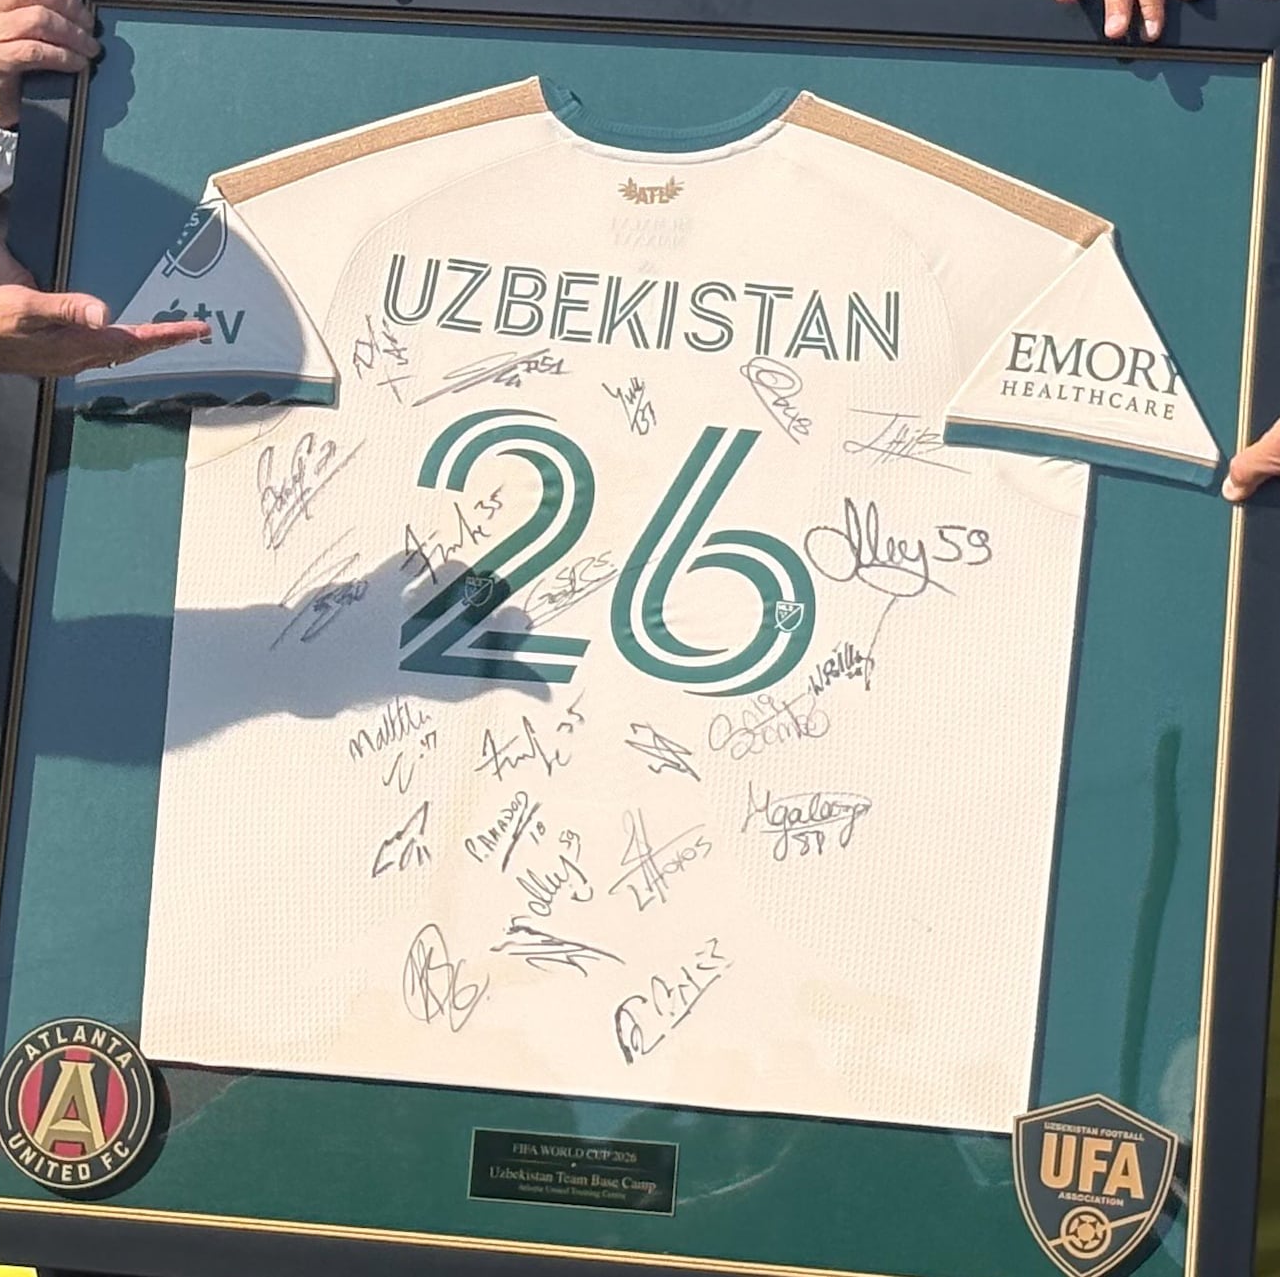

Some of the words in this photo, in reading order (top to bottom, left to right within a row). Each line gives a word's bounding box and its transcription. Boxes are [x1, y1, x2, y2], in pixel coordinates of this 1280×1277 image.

[383, 253, 900, 363] UZBEKISTAN
[1001, 380, 1176, 421] HEALTHCARE
[399, 408, 816, 697] 26
[24, 1025, 134, 1069] ATLANTA
[512, 1143, 538, 1157] FIFA
[541, 1144, 584, 1159] WORLD
[586, 1147, 611, 1161] CUP
[1043, 1121, 1099, 1138] UZBEKISTAN
[1100, 1127, 1145, 1142] FOOTBALL
[8, 1133, 91, 1181] UNITED
[101, 1140, 130, 1171] FC
[1040, 1132, 1145, 1200] UFA
[489, 1166, 553, 1184] Uzbekistan
[556, 1170, 588, 1186] Team
[590, 1174, 619, 1189] Base
[621, 1176, 658, 1195] Camp
[1058, 1191, 1124, 1207] ASSOCIATION
